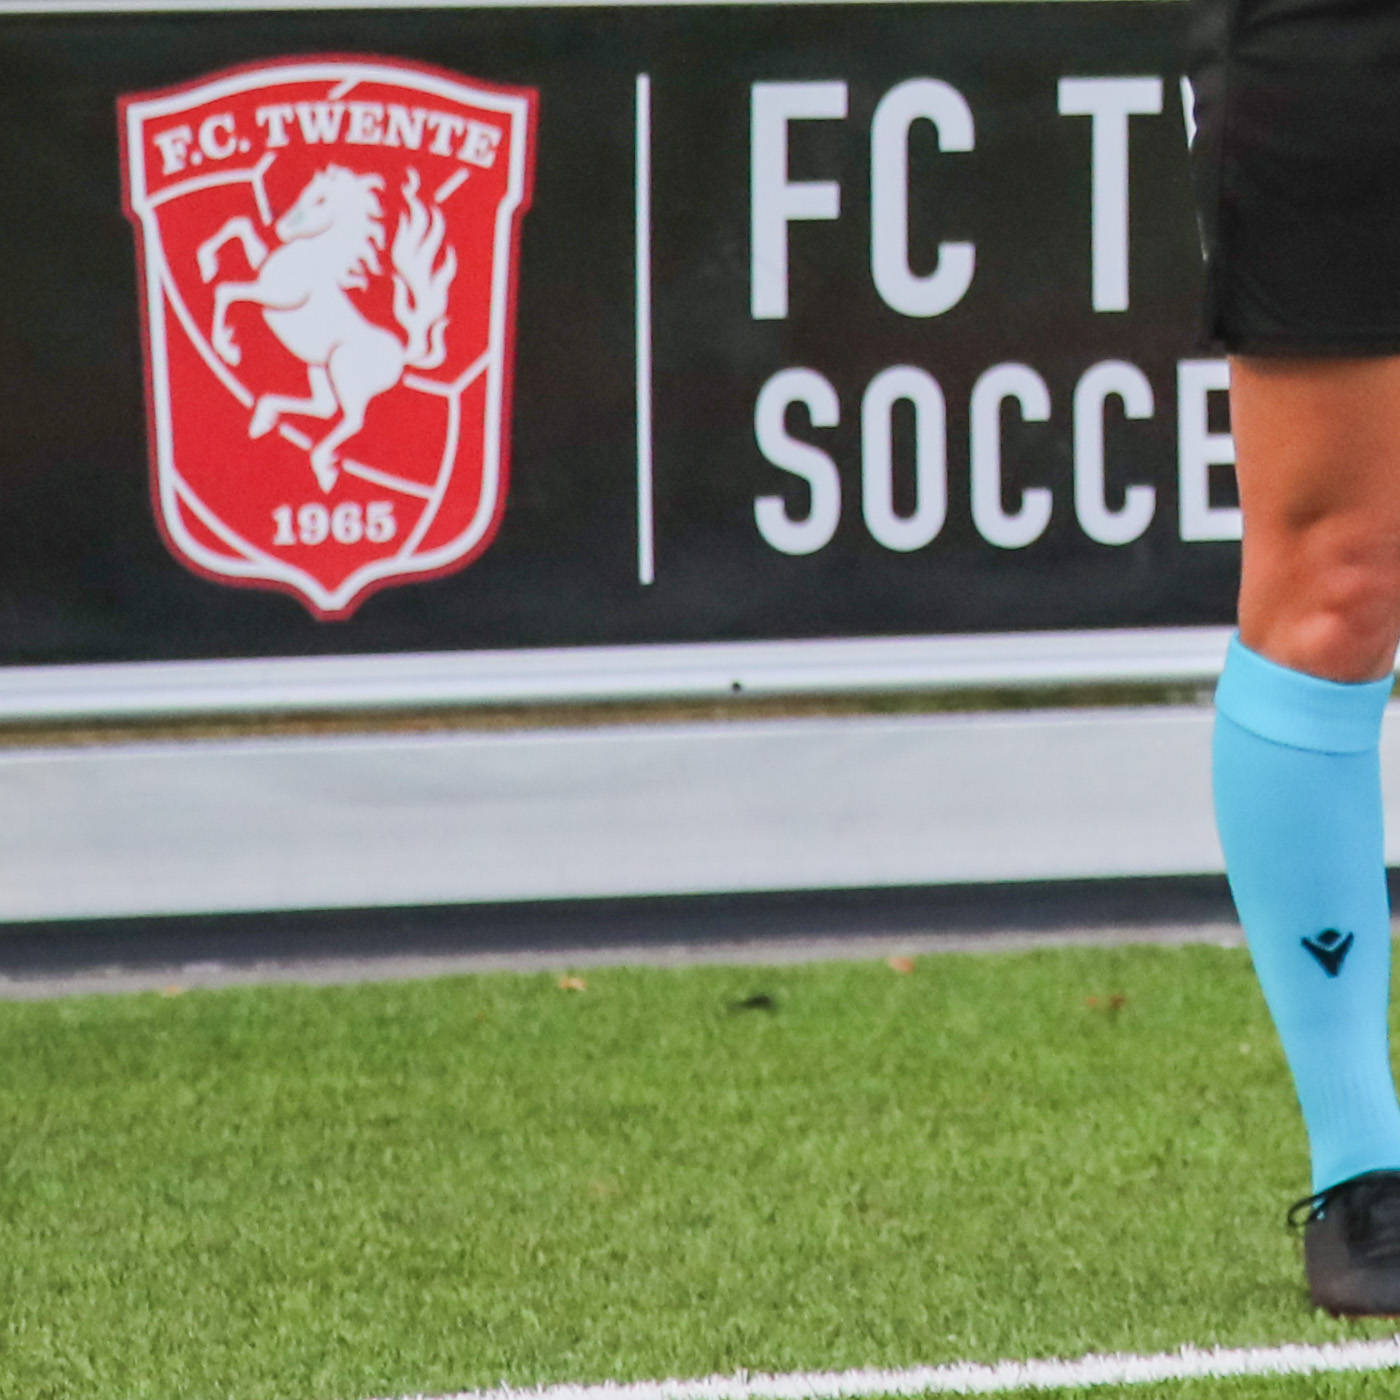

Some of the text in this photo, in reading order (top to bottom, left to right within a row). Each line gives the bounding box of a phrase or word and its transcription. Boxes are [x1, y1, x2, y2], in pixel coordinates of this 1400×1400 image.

[153, 100, 502, 176] F.C. TWENTE
[750, 77, 976, 321] FC
[272, 502, 398, 546] 1965
[753, 358, 1244, 557] SOCCE
